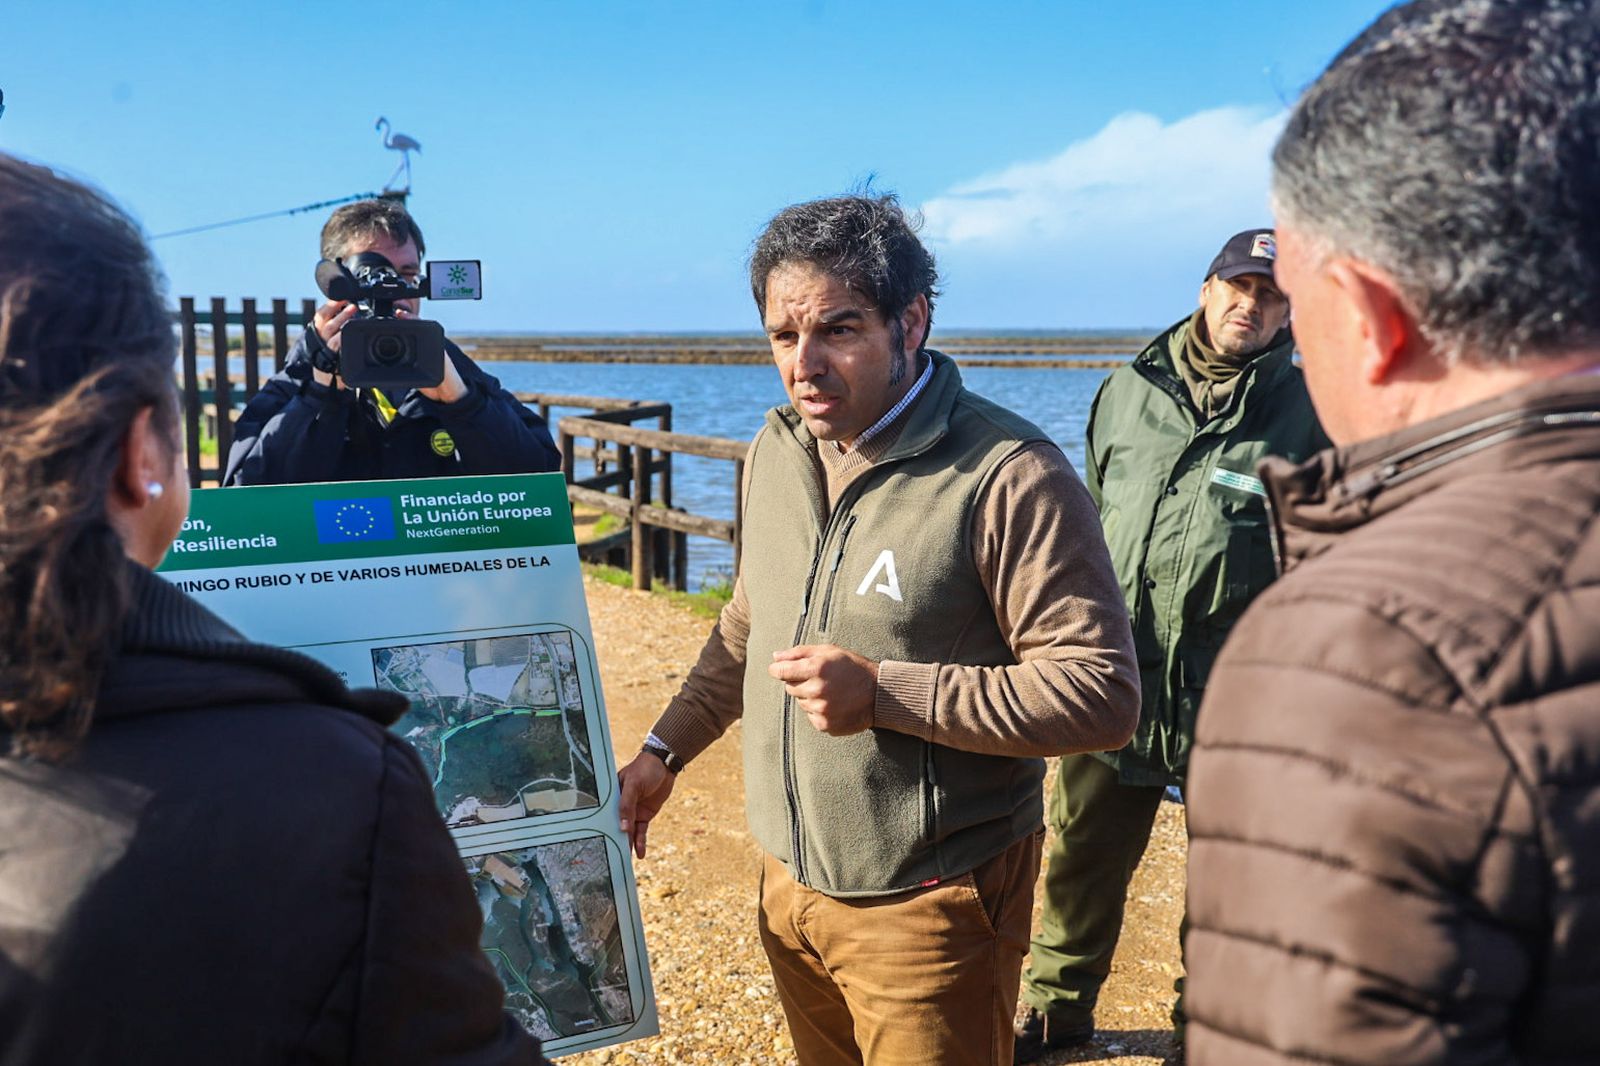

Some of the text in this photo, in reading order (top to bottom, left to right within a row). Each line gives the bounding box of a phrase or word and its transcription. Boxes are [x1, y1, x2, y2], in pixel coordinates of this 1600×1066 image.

[400, 490, 526, 507] Financiado por
[403, 506, 552, 525] La Unión Europea
[406, 525, 500, 538] NextGeneration
[173, 534, 277, 553] Resiliencia
[235, 574, 292, 589] RUBIO
[295, 572, 306, 584] Y
[310, 570, 335, 583] DE
[337, 566, 401, 581] VARIOS
[405, 559, 503, 576] HUMEDALES
[506, 557, 528, 569] DE
[530, 556, 551, 567] LA
